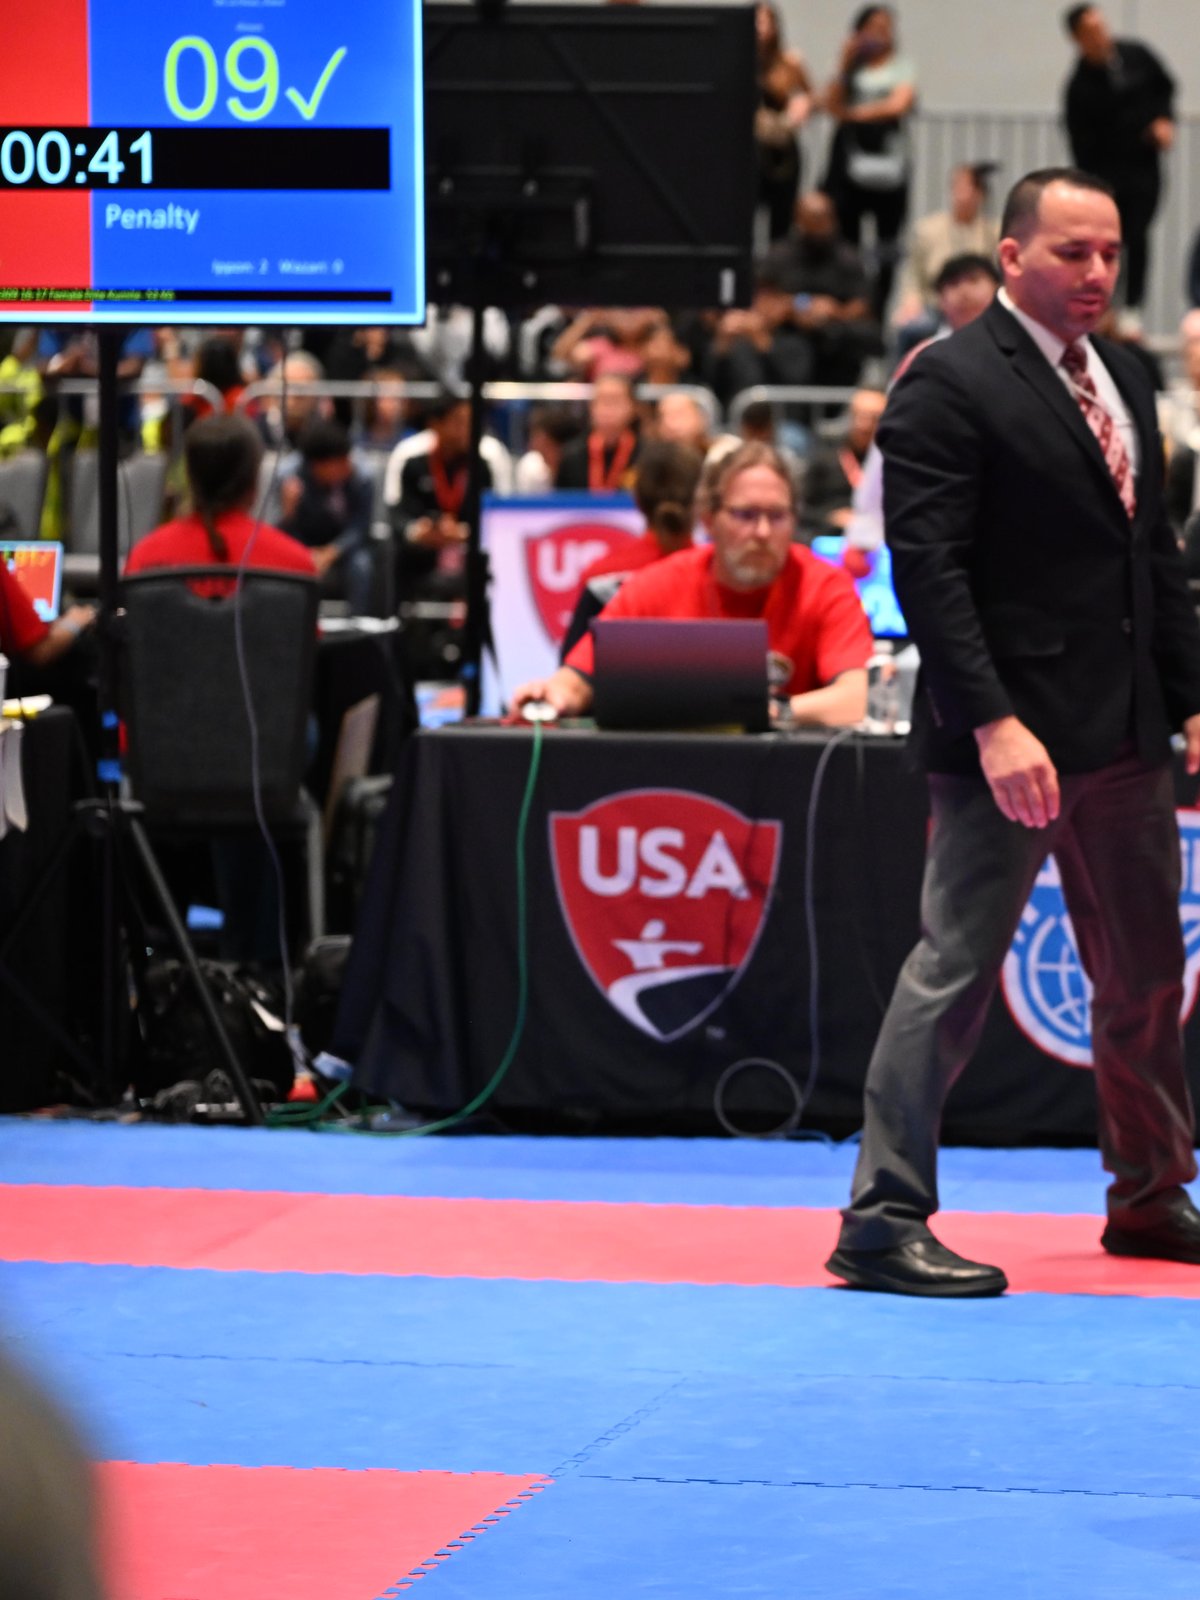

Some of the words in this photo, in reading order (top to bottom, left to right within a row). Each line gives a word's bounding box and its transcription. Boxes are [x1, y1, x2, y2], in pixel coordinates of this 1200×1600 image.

[164, 35, 279, 122] 09
[0, 130, 153, 184] 00:41
[105, 203, 200, 235] Penalty
[579, 825, 750, 899] USA
